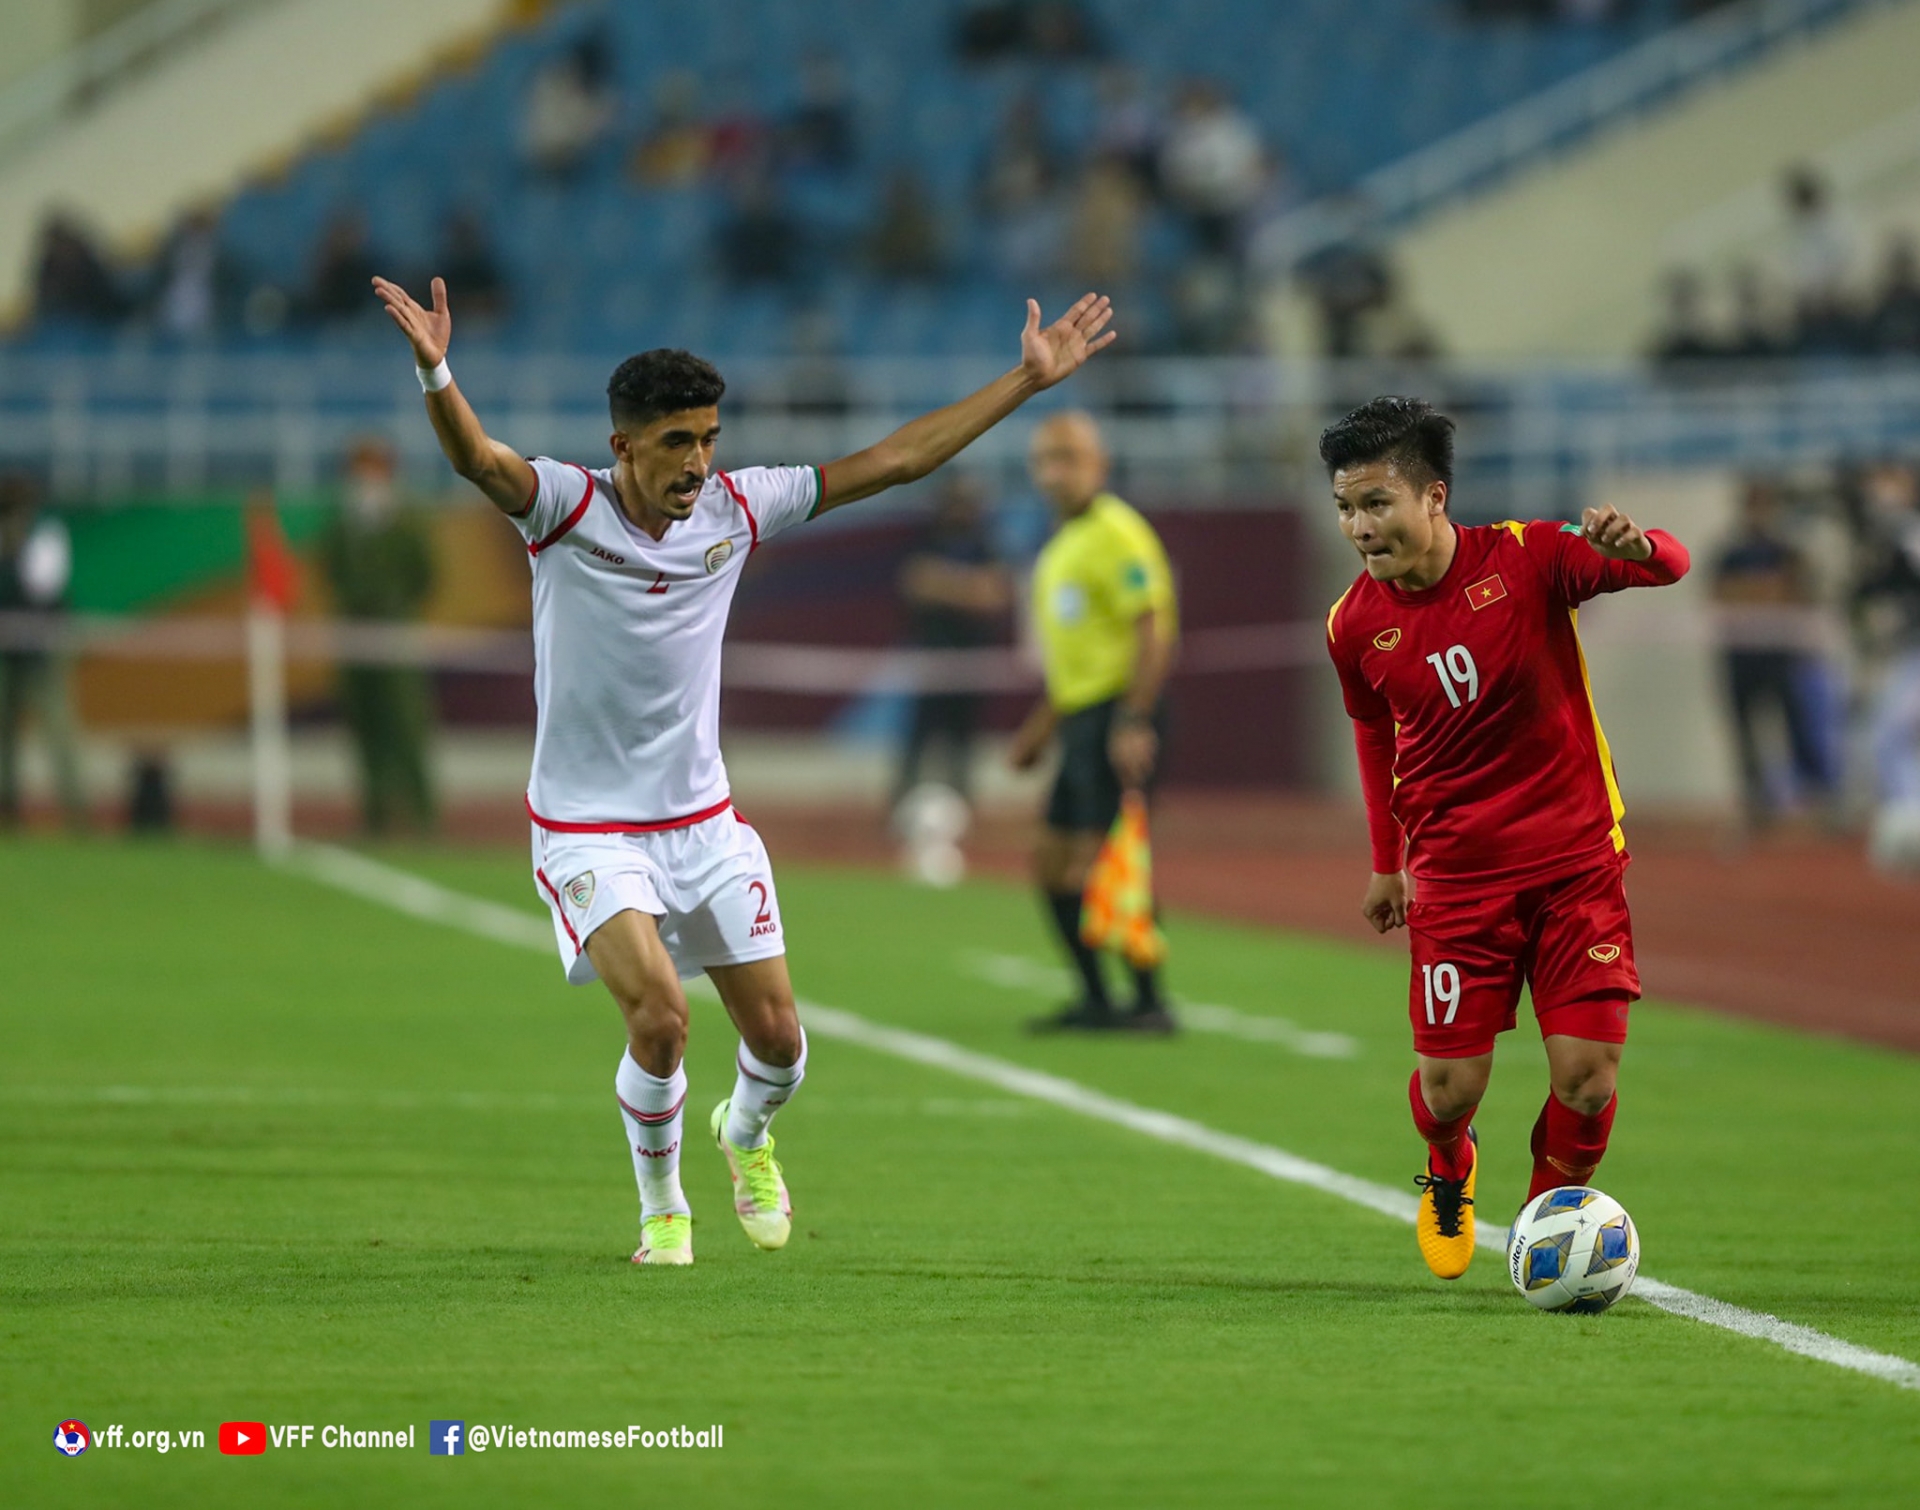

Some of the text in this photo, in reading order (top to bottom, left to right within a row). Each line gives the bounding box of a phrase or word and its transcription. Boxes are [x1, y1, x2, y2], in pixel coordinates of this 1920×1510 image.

[590, 547, 625, 565] JAKO
[1426, 644, 1479, 709] 19
[748, 880, 771, 924] 2
[749, 923, 776, 938] JAKO
[1422, 962, 1461, 1025] 19
[636, 1141, 677, 1158] JAKO
[1513, 1234, 1527, 1285] molten
